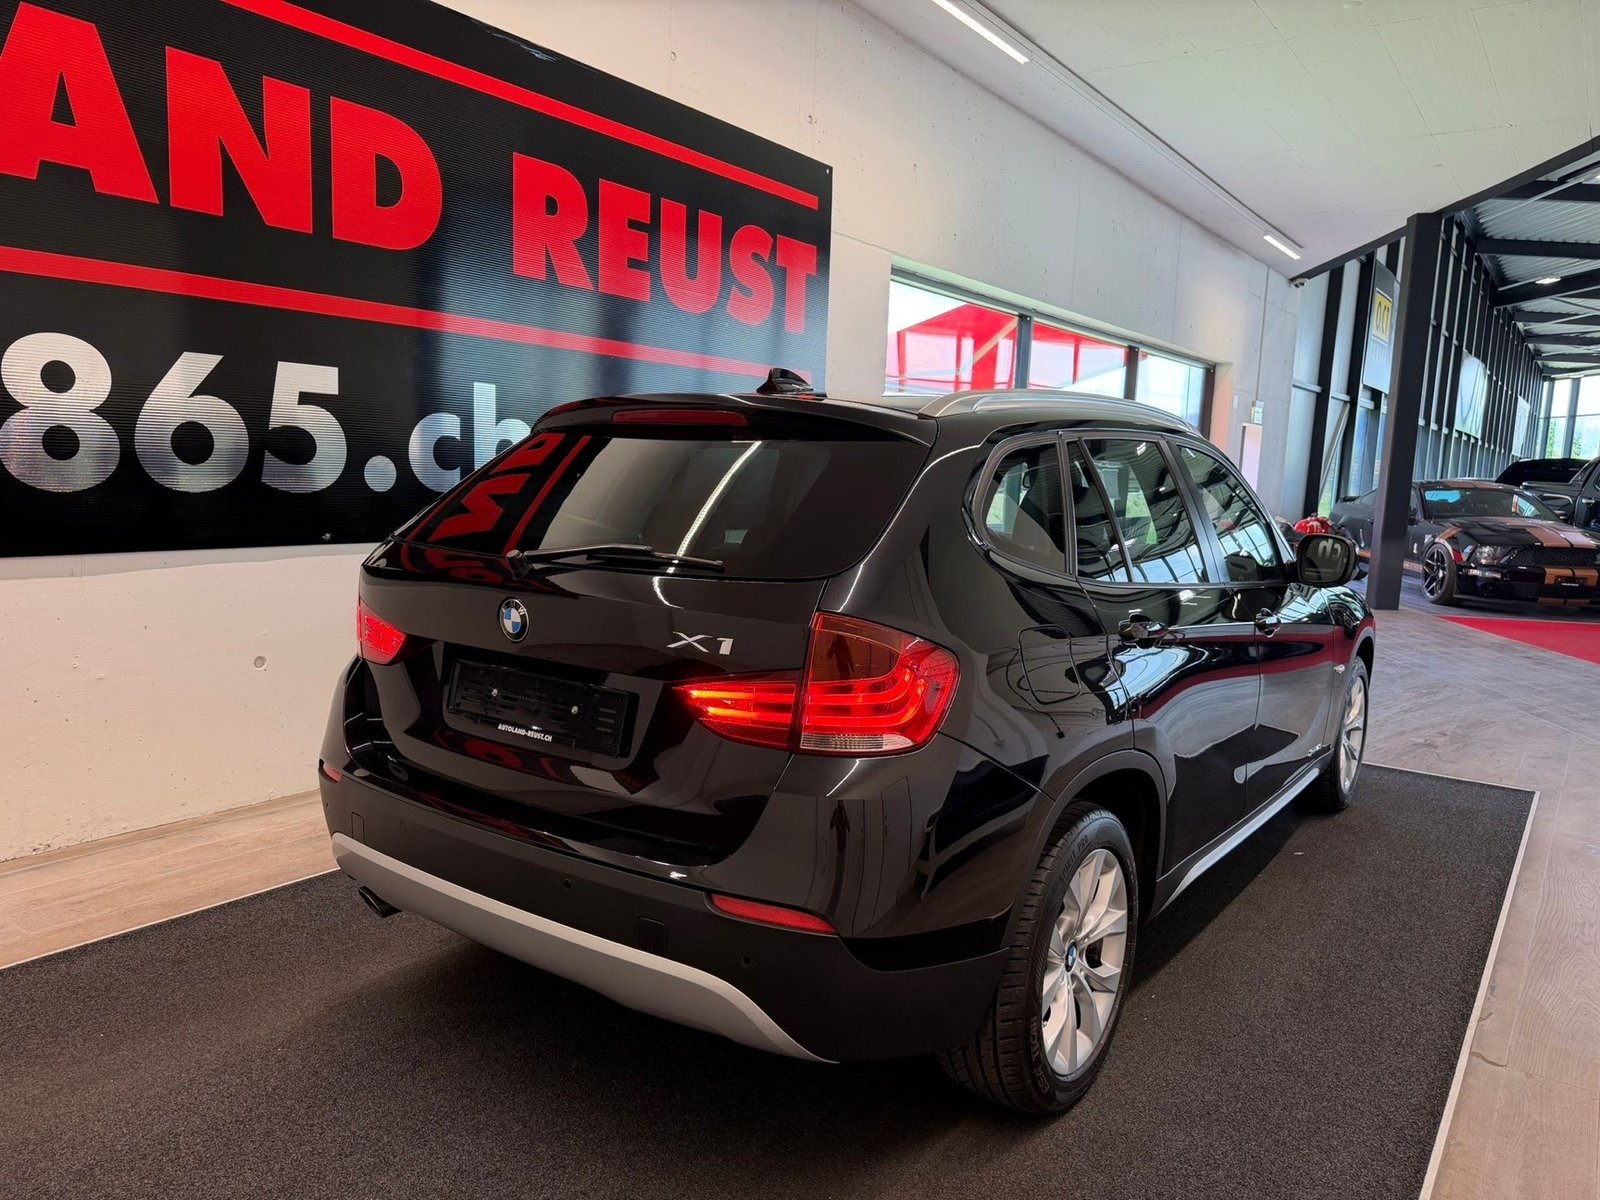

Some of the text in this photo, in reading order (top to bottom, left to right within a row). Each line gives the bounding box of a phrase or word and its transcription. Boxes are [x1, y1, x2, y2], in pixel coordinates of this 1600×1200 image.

[0, 2, 818, 334] AND REUST
[0, 332, 531, 493] 865.ch
[666, 631, 734, 655] X1
